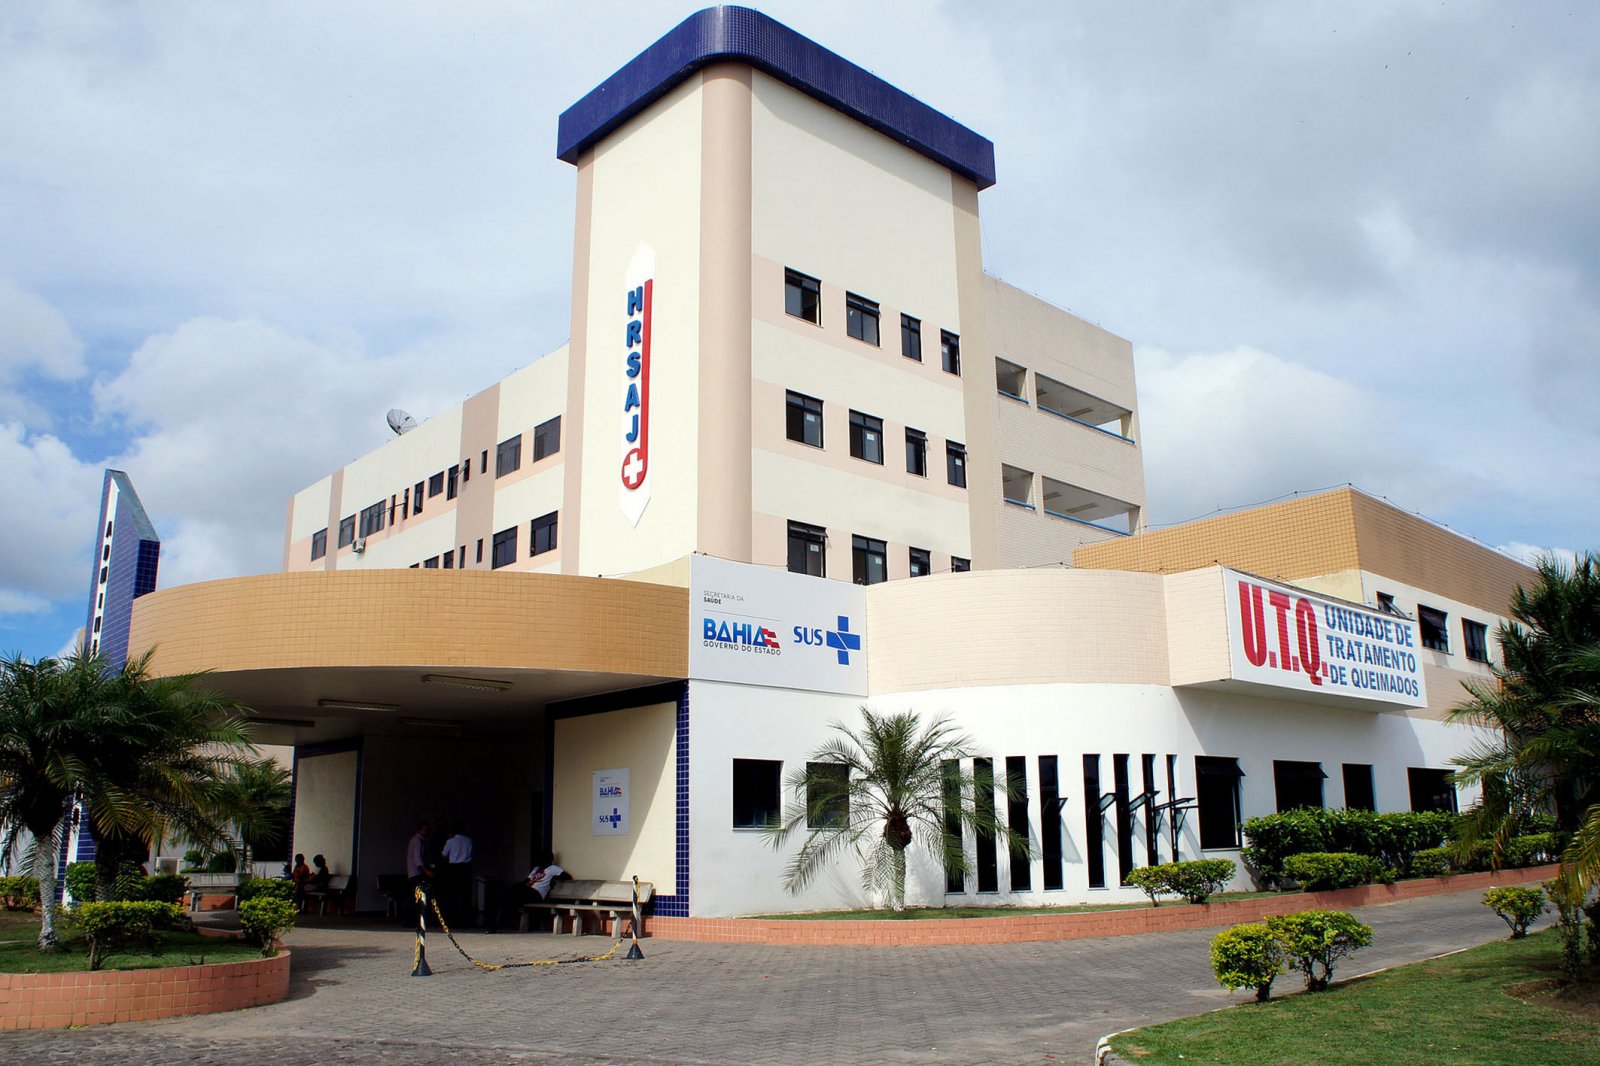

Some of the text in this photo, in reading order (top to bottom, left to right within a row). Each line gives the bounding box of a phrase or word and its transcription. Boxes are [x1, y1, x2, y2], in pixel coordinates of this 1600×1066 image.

[624, 285, 643, 443] HRSAJ
[703, 590, 735, 601] SECRETARIA
[703, 596, 722, 605] SAÚDE
[703, 617, 767, 647] BAHIA
[793, 625, 823, 646] SUS
[1238, 580, 1328, 686] U.T.Q.
[1324, 604, 1414, 648] UNIDADE DE
[703, 640, 739, 651] GOVERNO
[754, 647, 781, 656] ESTADO
[1326, 634, 1416, 674] TRATAMENTO
[1329, 664, 1419, 697] DE QUEIMADOS
[600, 787, 617, 796] BAHIA
[599, 815, 609, 824] SUS
